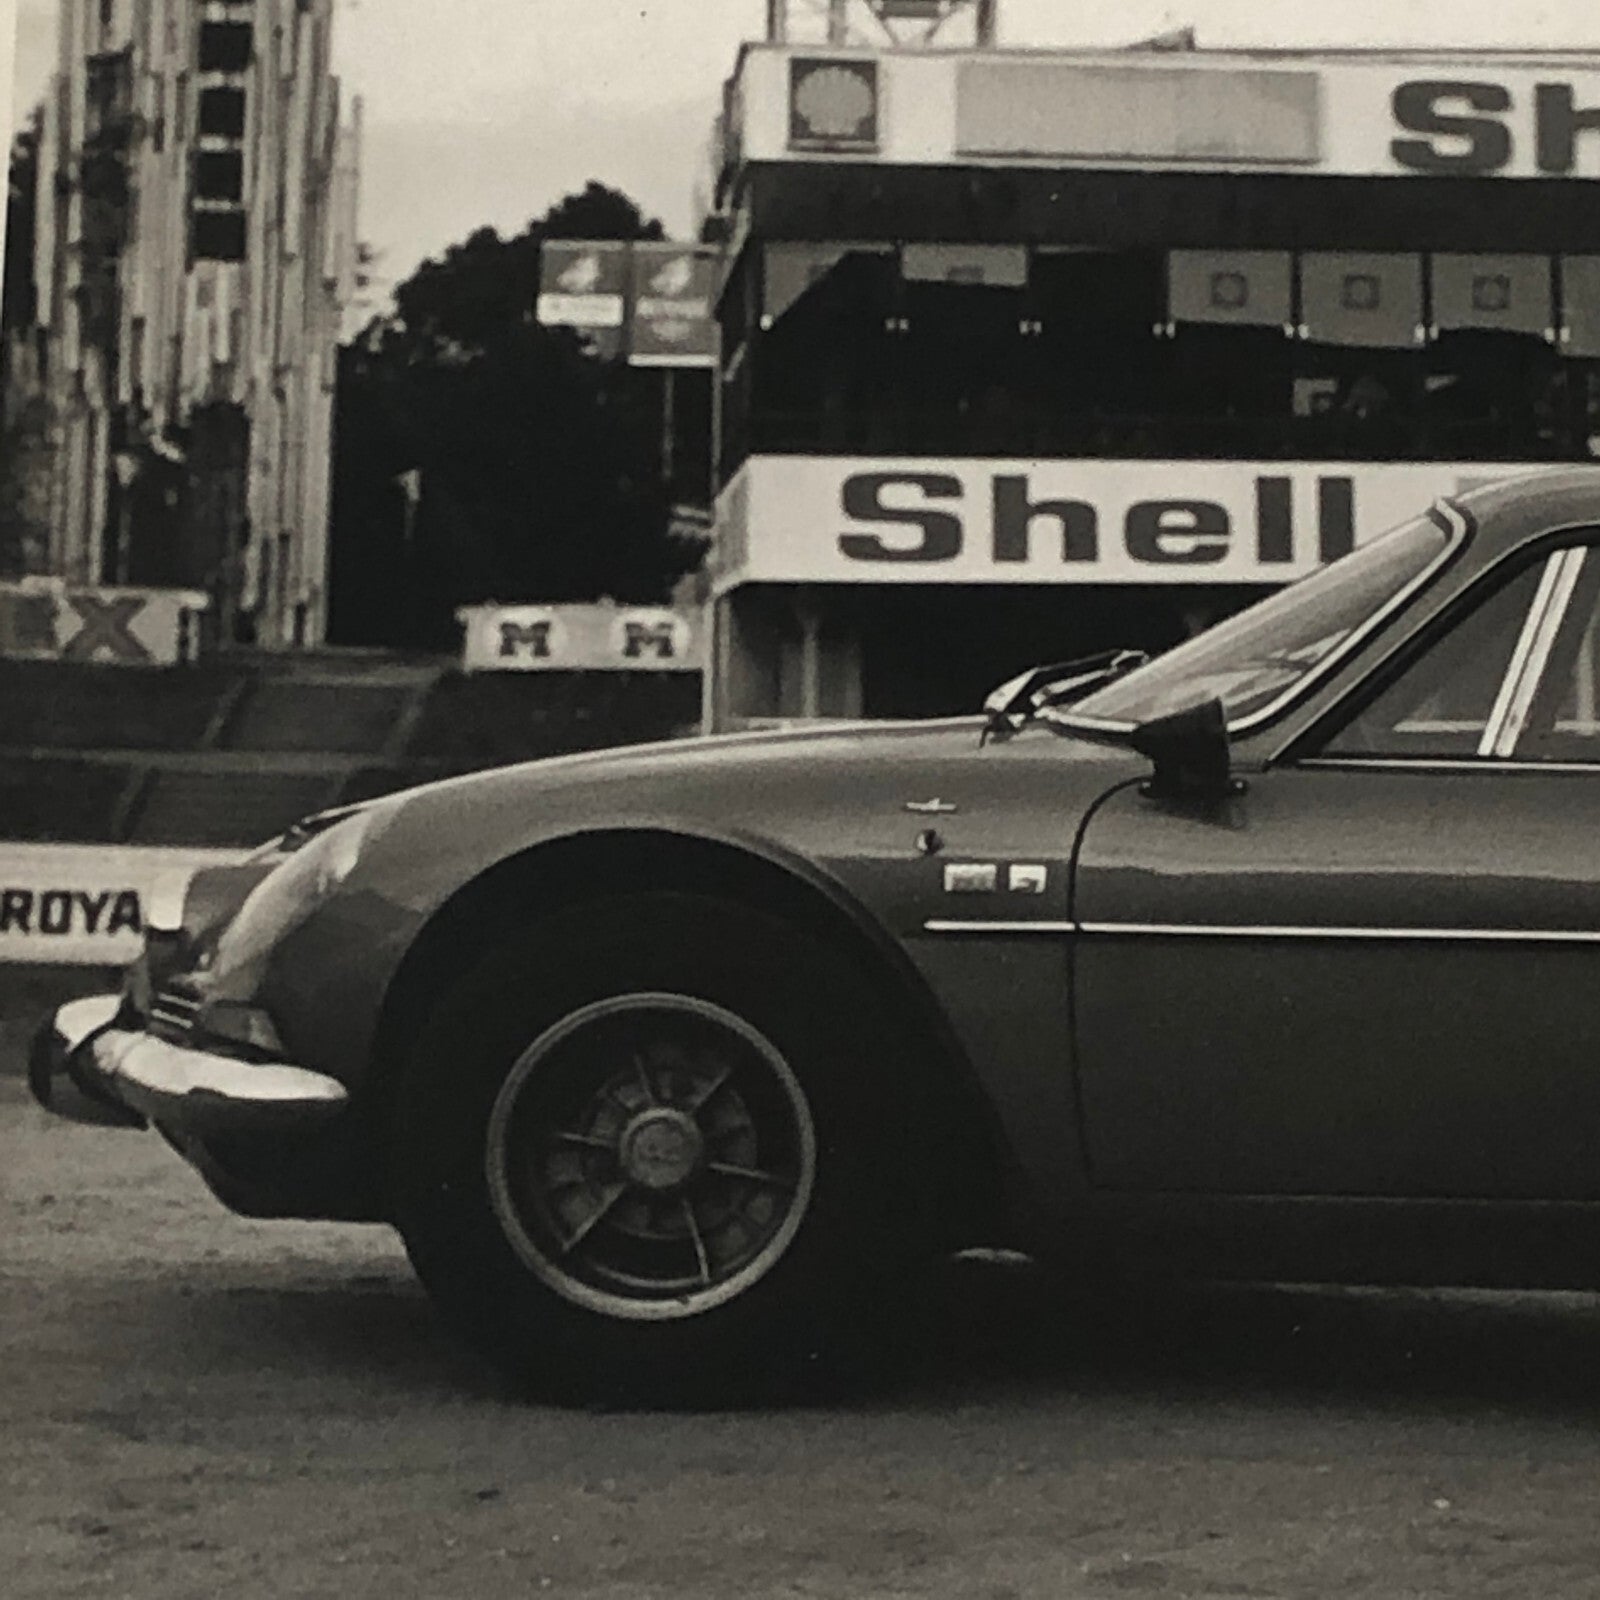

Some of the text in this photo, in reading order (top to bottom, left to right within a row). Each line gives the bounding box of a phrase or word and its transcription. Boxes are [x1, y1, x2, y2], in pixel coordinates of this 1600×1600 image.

[838, 471, 1355, 564] Shell
[501, 622, 551, 656] M
[0, 890, 142, 934] ROYA
